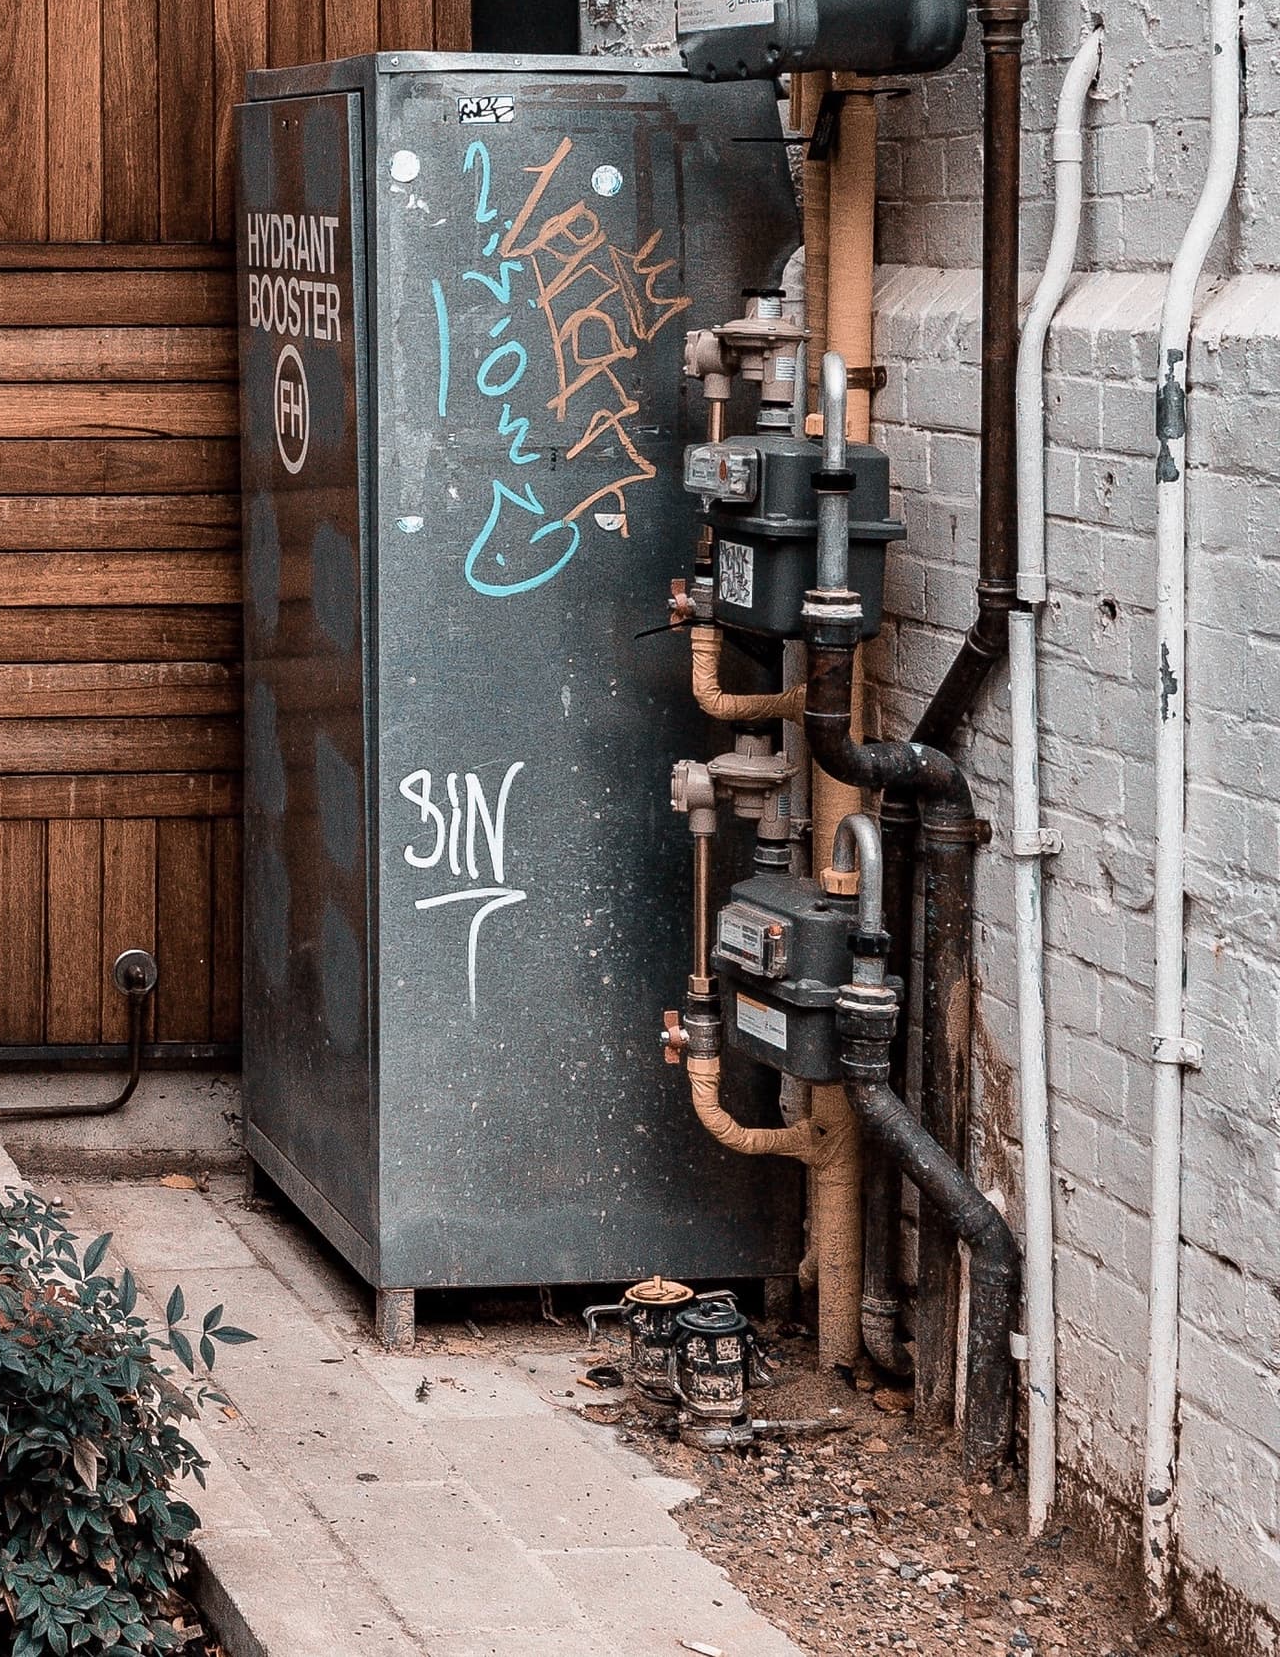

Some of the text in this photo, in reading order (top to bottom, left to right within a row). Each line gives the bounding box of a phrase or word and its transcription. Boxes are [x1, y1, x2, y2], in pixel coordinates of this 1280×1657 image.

[247, 213, 339, 274] HYDRANT
[248, 274, 342, 342] BOOSTER
[279, 380, 303, 439] FH
